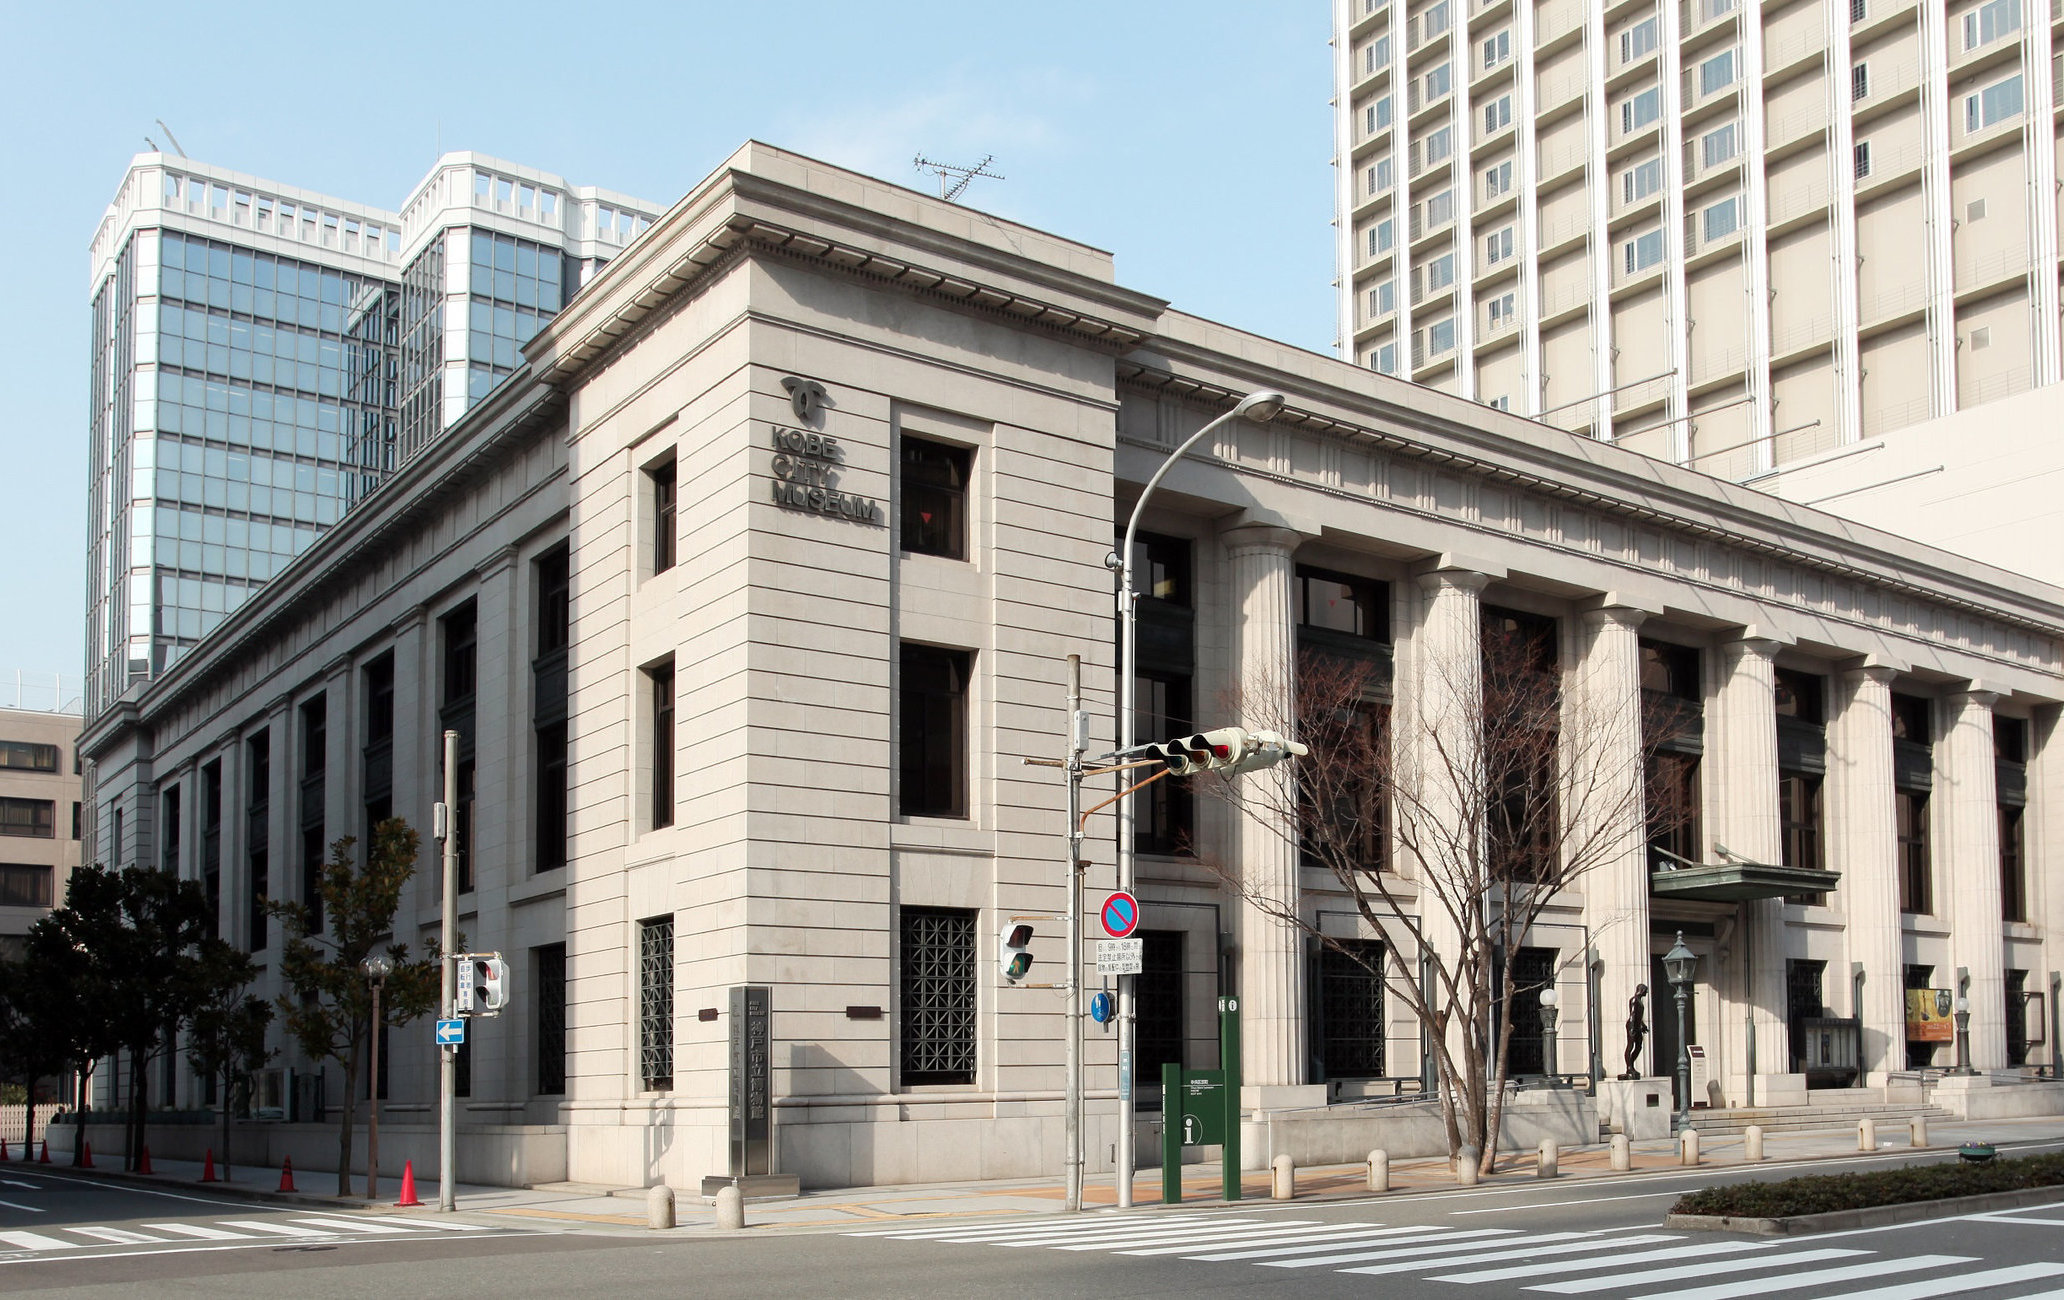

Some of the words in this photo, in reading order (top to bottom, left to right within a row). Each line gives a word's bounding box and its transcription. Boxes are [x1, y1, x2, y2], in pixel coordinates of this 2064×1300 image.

[771, 426, 838, 460] KOBE
[771, 453, 833, 485] CITY
[771, 480, 876, 520] MUSEUM
[750, 1021, 766, 1119] 神戸市立博物館
